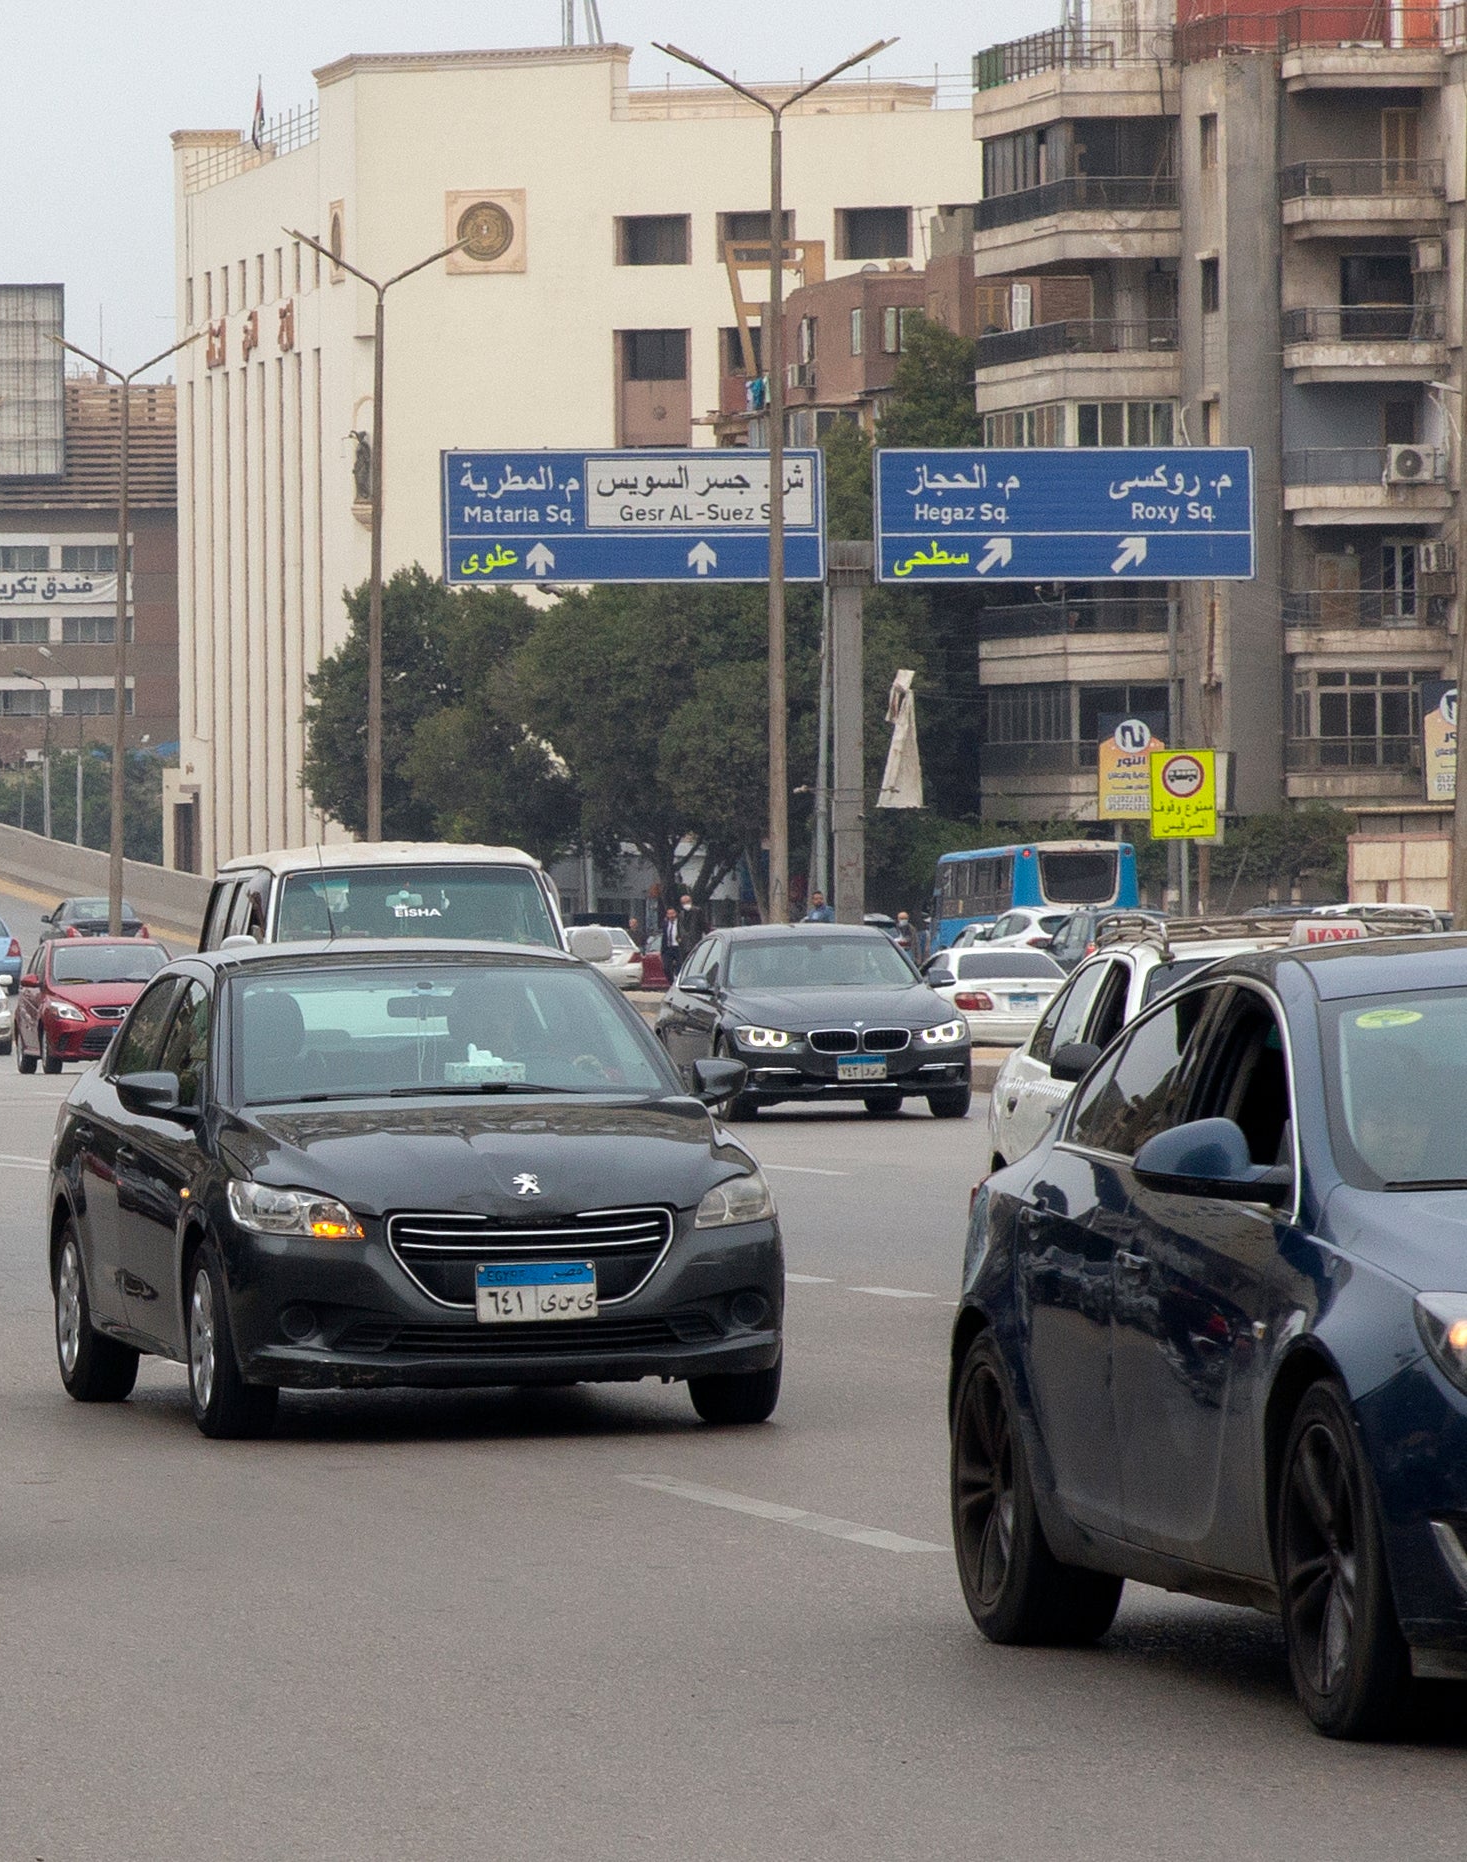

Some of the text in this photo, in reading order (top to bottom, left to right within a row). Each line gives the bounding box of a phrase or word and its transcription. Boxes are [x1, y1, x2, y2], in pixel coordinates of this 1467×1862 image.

[460, 462, 553, 499] المطرية
[597, 465, 689, 497] السويس
[695, 473, 751, 497] جسر
[906, 463, 987, 496] الحجاز
[464, 505, 575, 526] Mataria Sq.
[620, 505, 664, 522] Gesr
[915, 503, 1009, 525] Hegaz Sq.
[1132, 501, 1216, 524] Roxy Sq.
[41, 577, 93, 600] فندق
[1153, 799, 1181, 815] وقوف
[1185, 800, 1213, 817] ممنوع
[1310, 929, 1358, 943] TAXI
